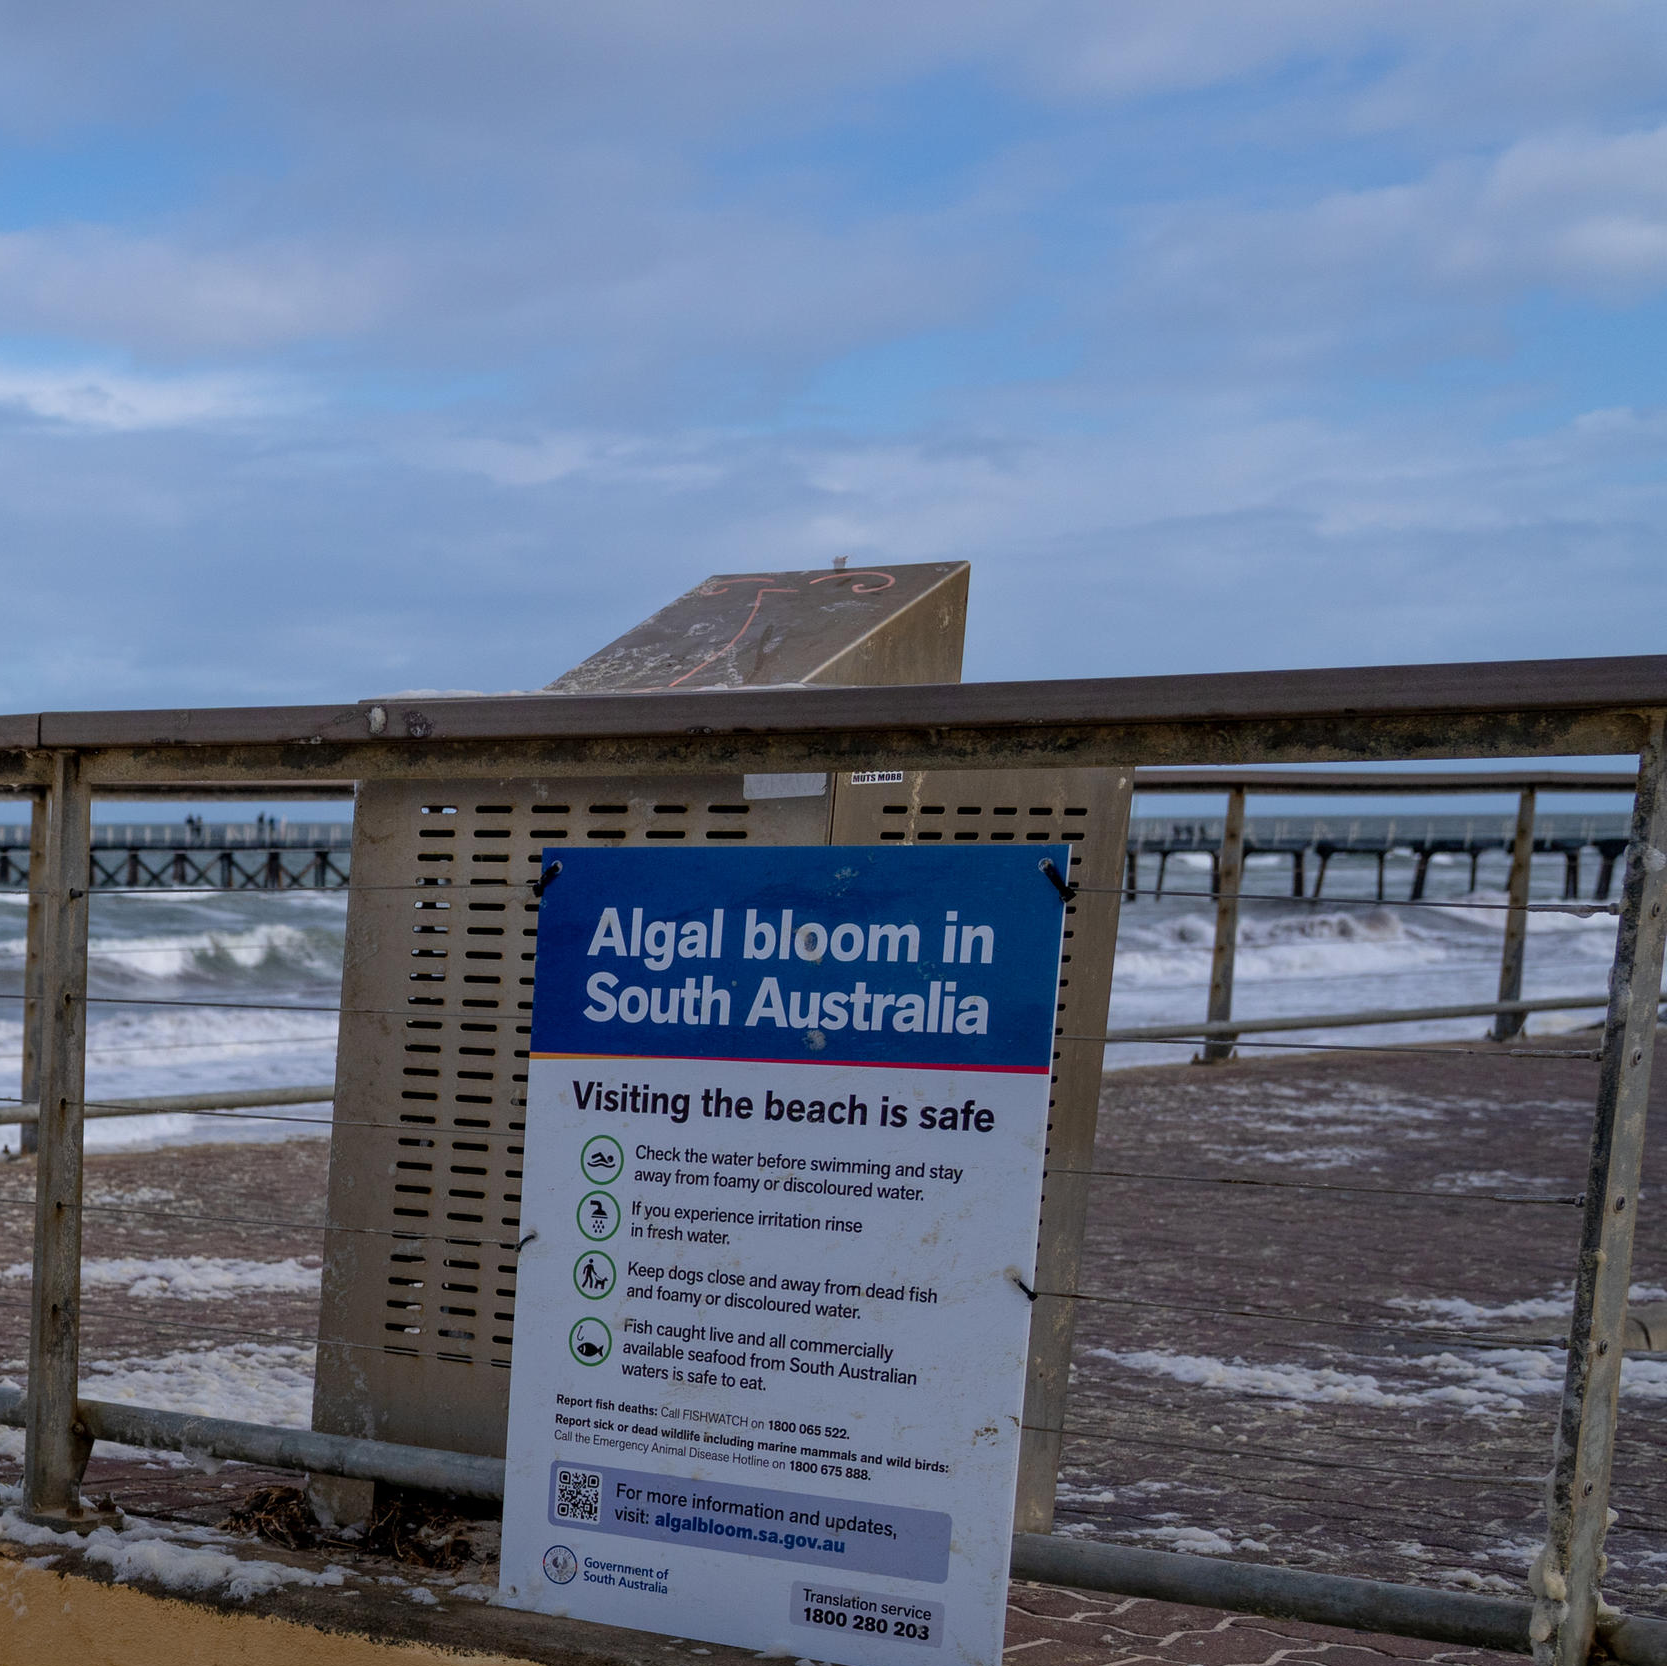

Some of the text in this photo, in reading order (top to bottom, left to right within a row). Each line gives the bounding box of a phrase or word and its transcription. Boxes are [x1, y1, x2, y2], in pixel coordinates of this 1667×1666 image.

[877, 773, 902, 781] MOBB
[587, 908, 994, 971] Algal bloom in
[583, 972, 989, 1034] South Australia
[572, 1080, 995, 1133] Visiting the beach is safe
[635, 1144, 963, 1184] Check the water before swimming and stay
[634, 1169, 924, 1201] away from foamy or discoloured water.
[631, 1200, 863, 1234] If you experience irritation rinse
[631, 1222, 730, 1245] in fresh water.
[626, 1284, 861, 1320] and foamy or discoloured water.
[627, 1261, 937, 1304] Keep dogs close and away from dead fish
[624, 1318, 894, 1364] Fish caught live and all commercially
[621, 1363, 766, 1391] waters is safe to eat.
[622, 1341, 917, 1386] available seafood from South Australian
[556, 1393, 850, 1440] Report fish deaths: Call FISHWATCH on 1800 065 522.
[554, 1429, 871, 1481] Call the Emergency Animal Disease Hotline on 1800 675 888.
[555, 1413, 949, 1474] Report sick or dead wildlife including marine mammals and wild birds:
[614, 1506, 845, 1554] visit: algalbloom.sa.gov.au
[616, 1482, 897, 1540] For more information and updates,
[583, 1570, 615, 1586] South
[618, 1576, 668, 1594] Australia
[584, 1557, 654, 1578] Government
[656, 1568, 669, 1580] of
[803, 1588, 932, 1621] Translation service
[803, 1606, 930, 1641] 1800 280 203
